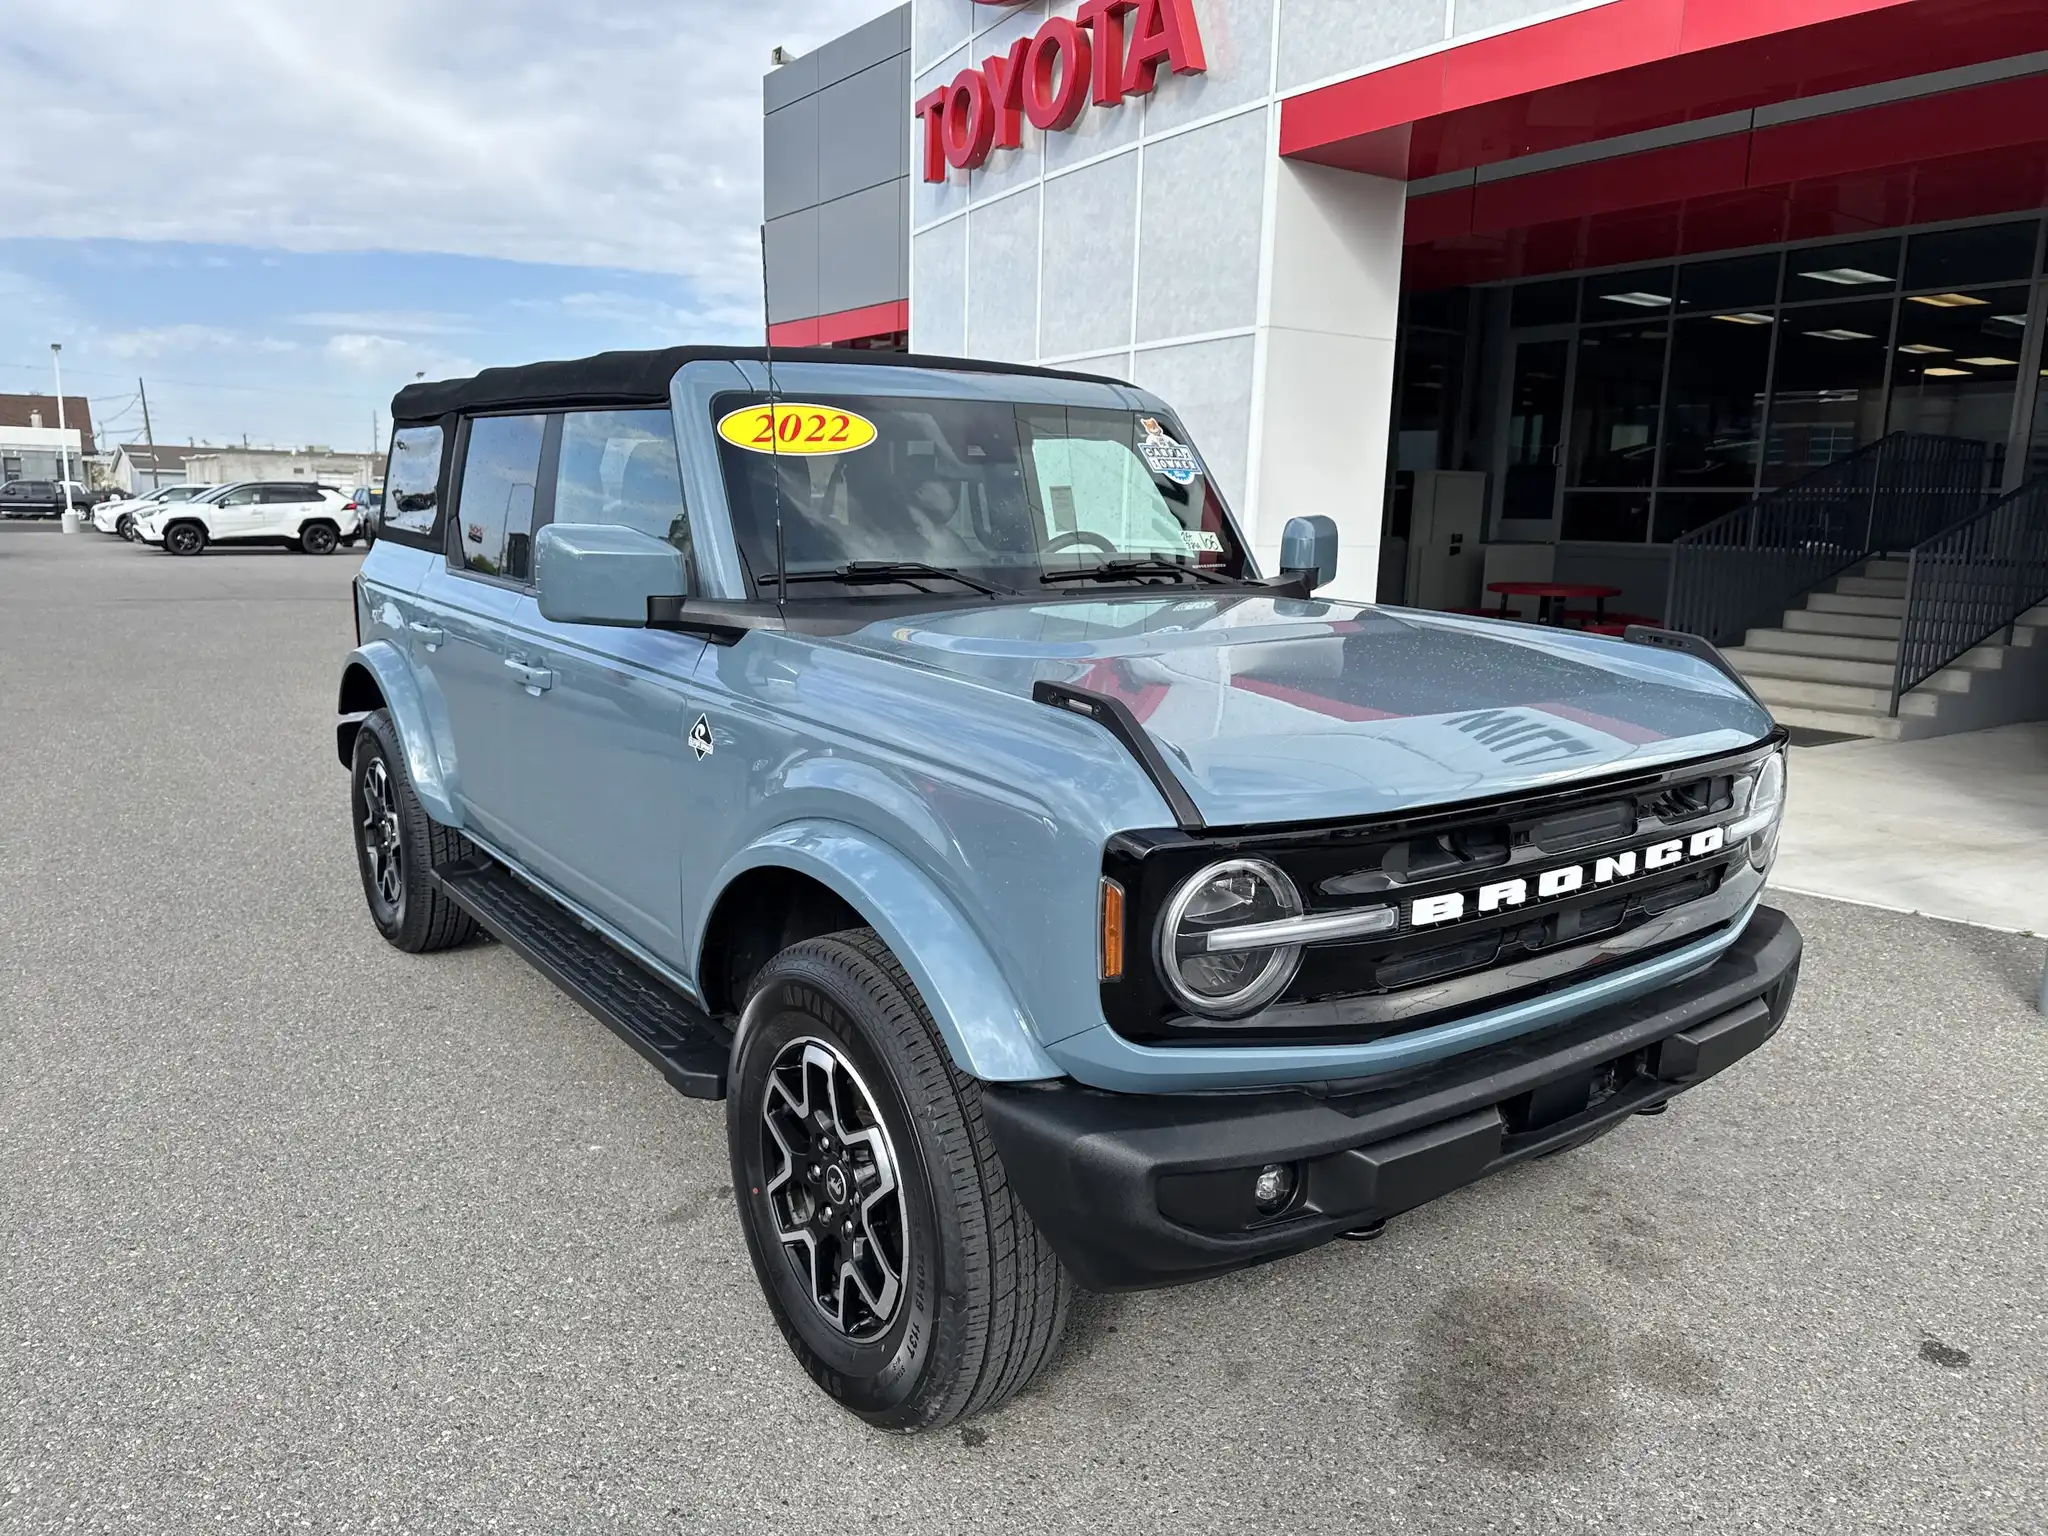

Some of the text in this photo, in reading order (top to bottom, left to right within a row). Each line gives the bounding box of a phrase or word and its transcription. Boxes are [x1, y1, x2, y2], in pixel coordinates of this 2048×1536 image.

[915, 0, 1207, 183] TOYOTA
[752, 413, 850, 442] 2022
[1144, 447, 1190, 460] CARFAX
[1411, 826, 1725, 927] BRONCO
